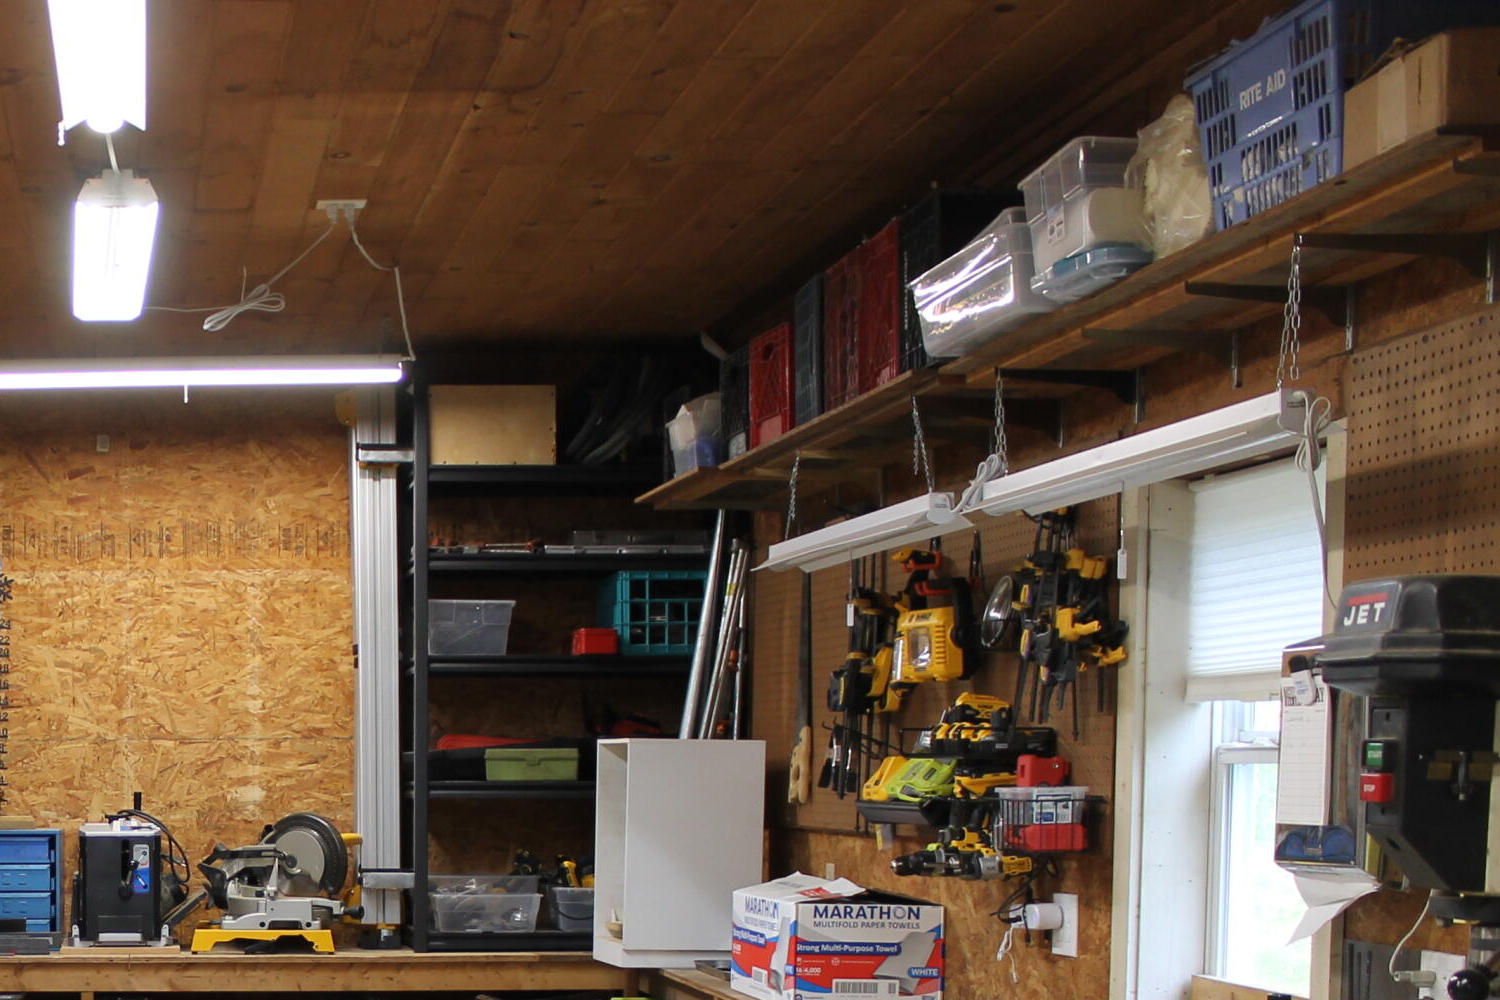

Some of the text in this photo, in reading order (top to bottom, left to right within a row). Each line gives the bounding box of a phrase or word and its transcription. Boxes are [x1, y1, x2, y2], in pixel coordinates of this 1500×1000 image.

[1239, 68, 1286, 111] RITE AID
[1343, 602, 1386, 627] JET
[813, 905, 920, 920] MARATHON
[813, 920, 920, 930] MULTIFOLD PAPER TOWELS
[797, 943, 820, 953] Strong
[821, 944, 874, 953] Multi-Purpose
[910, 968, 939, 976] WHITE
